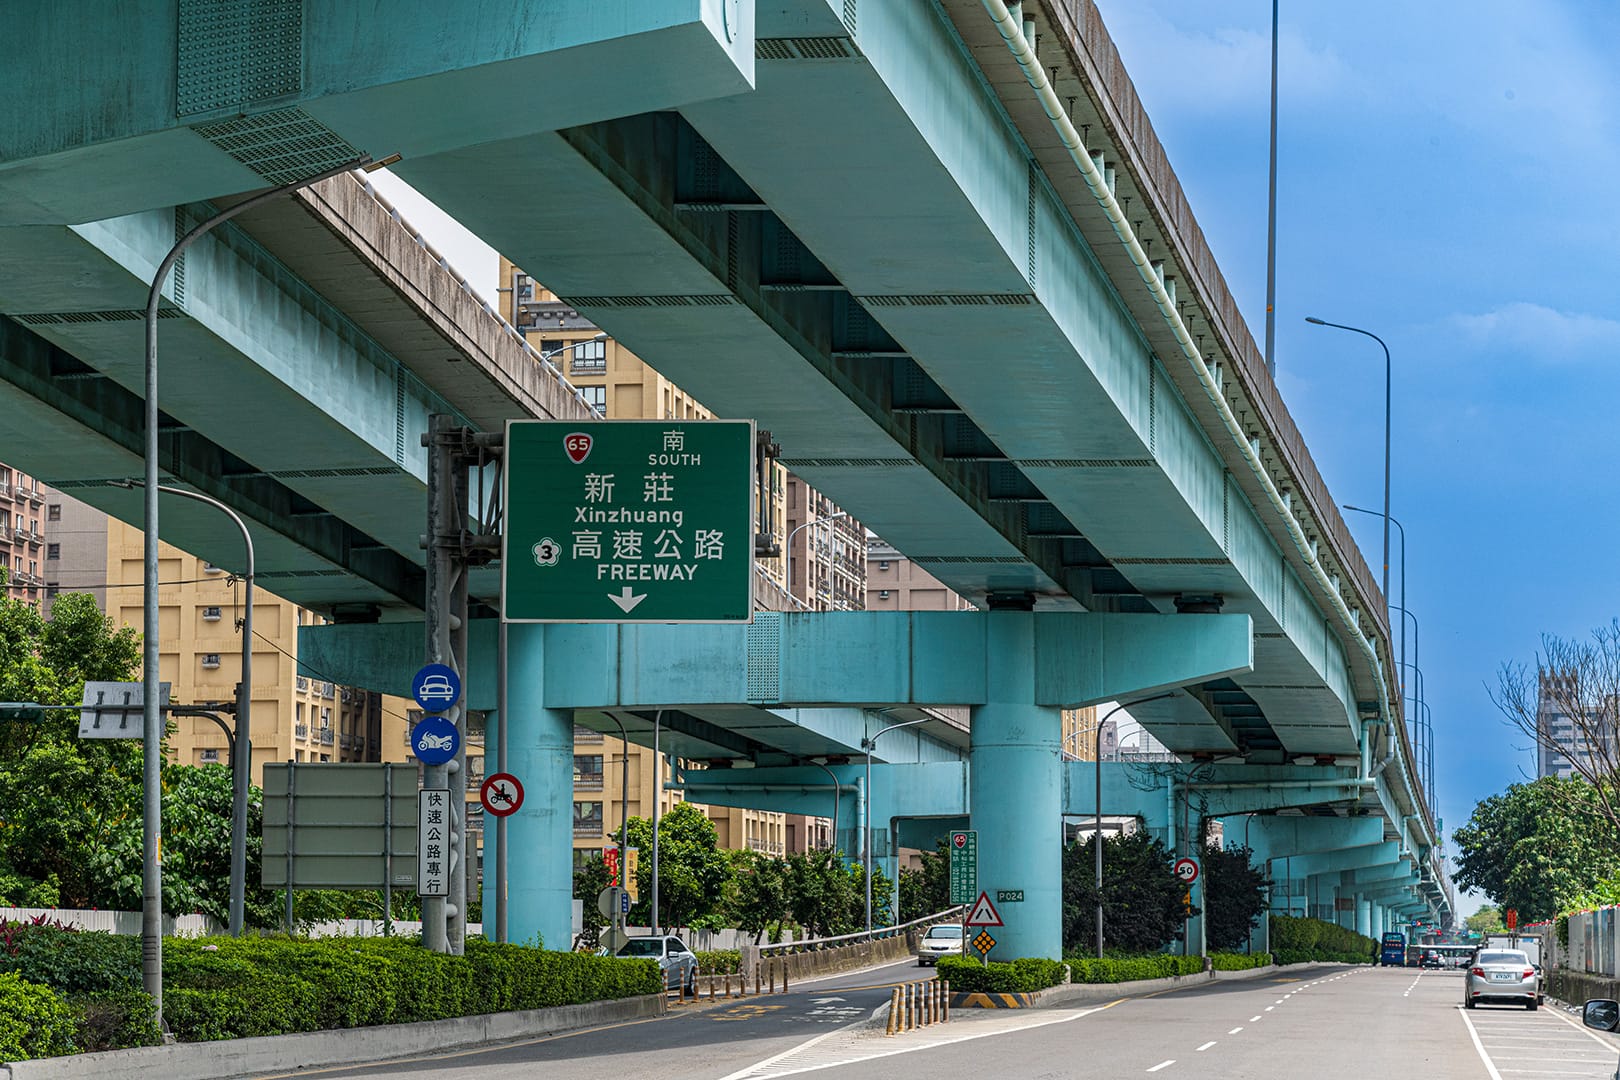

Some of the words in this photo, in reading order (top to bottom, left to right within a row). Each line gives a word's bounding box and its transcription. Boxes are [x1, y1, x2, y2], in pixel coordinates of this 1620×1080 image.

[568, 439, 589, 451] 65
[663, 430, 685, 452] 南
[648, 454, 702, 466] SOUTH
[584, 472, 675, 504] 新莊
[574, 507, 684, 528] Xinzhuang
[540, 545, 554, 561] 3
[571, 529, 725, 561] 高速公路
[597, 564, 698, 581] FREEWAY
[427, 794, 442, 893] 快速公路專行
[999, 892, 1023, 901] P024
